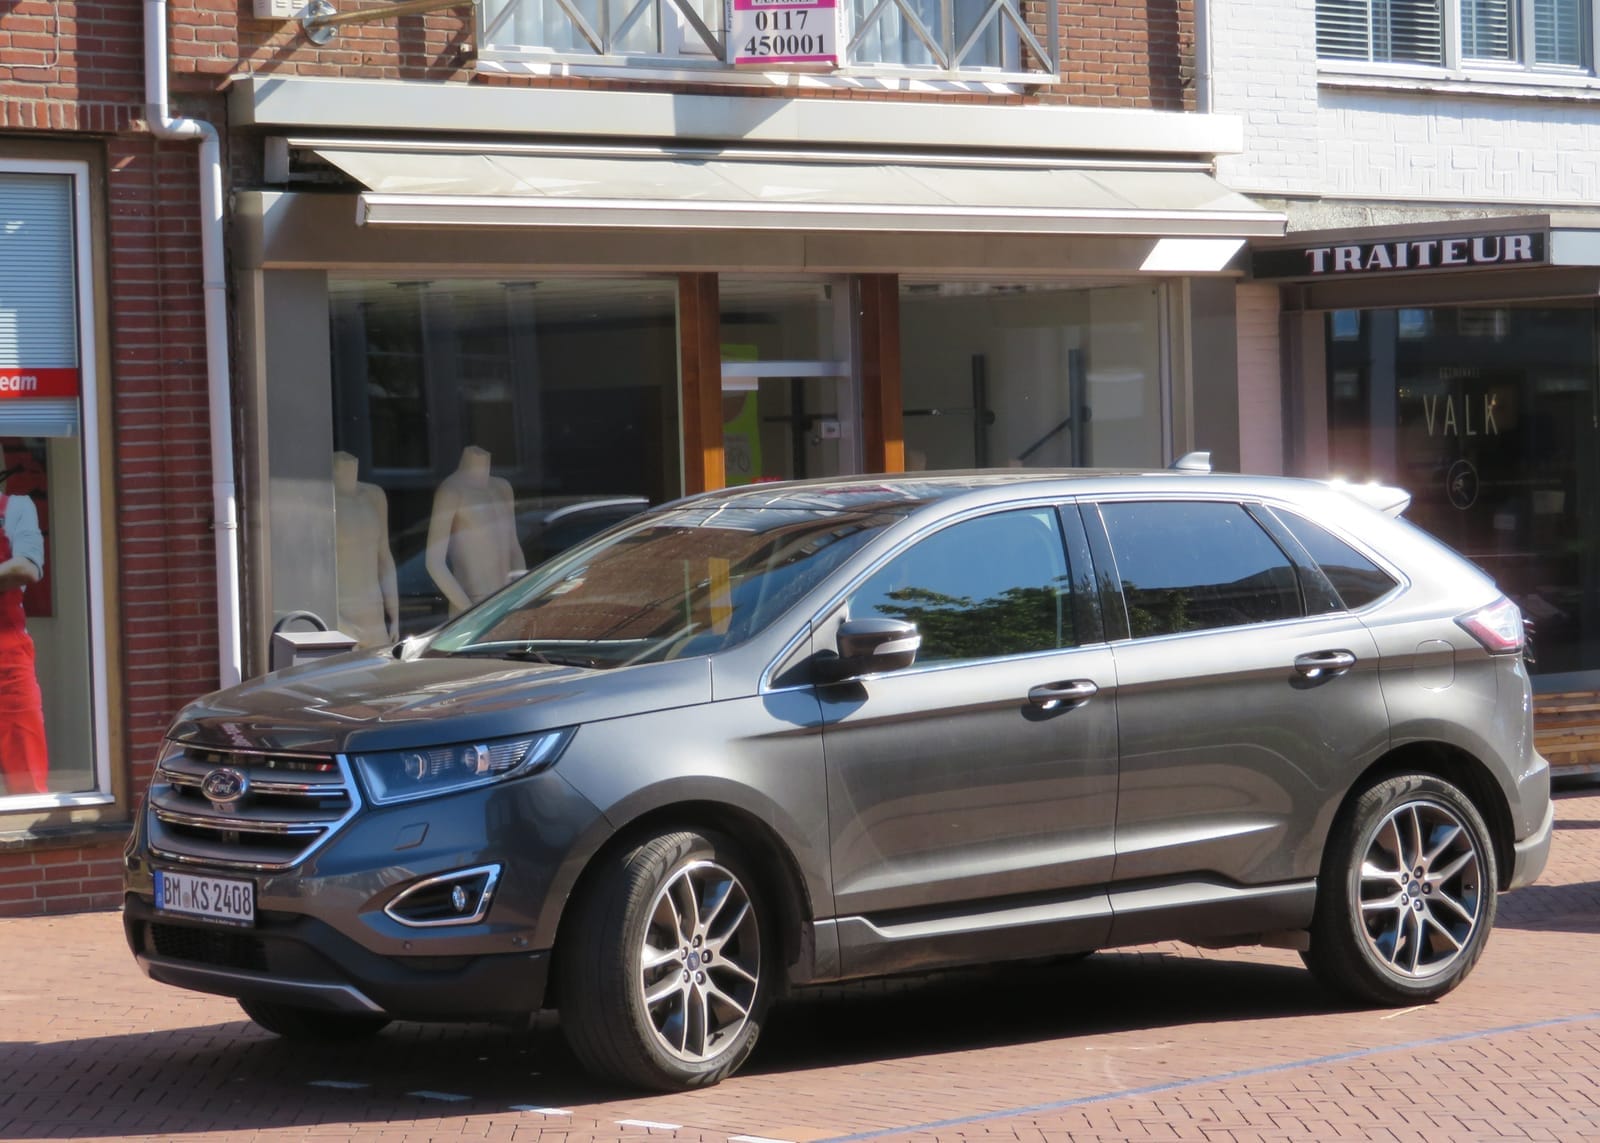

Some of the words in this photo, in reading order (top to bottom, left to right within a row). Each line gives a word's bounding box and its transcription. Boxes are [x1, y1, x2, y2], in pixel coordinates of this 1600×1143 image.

[755, 10, 808, 31] 0117
[744, 34, 824, 56] 450001
[1305, 234, 1532, 273] TRAITEUR
[1423, 394, 1498, 436] VALK
[207, 774, 234, 794] Ford
